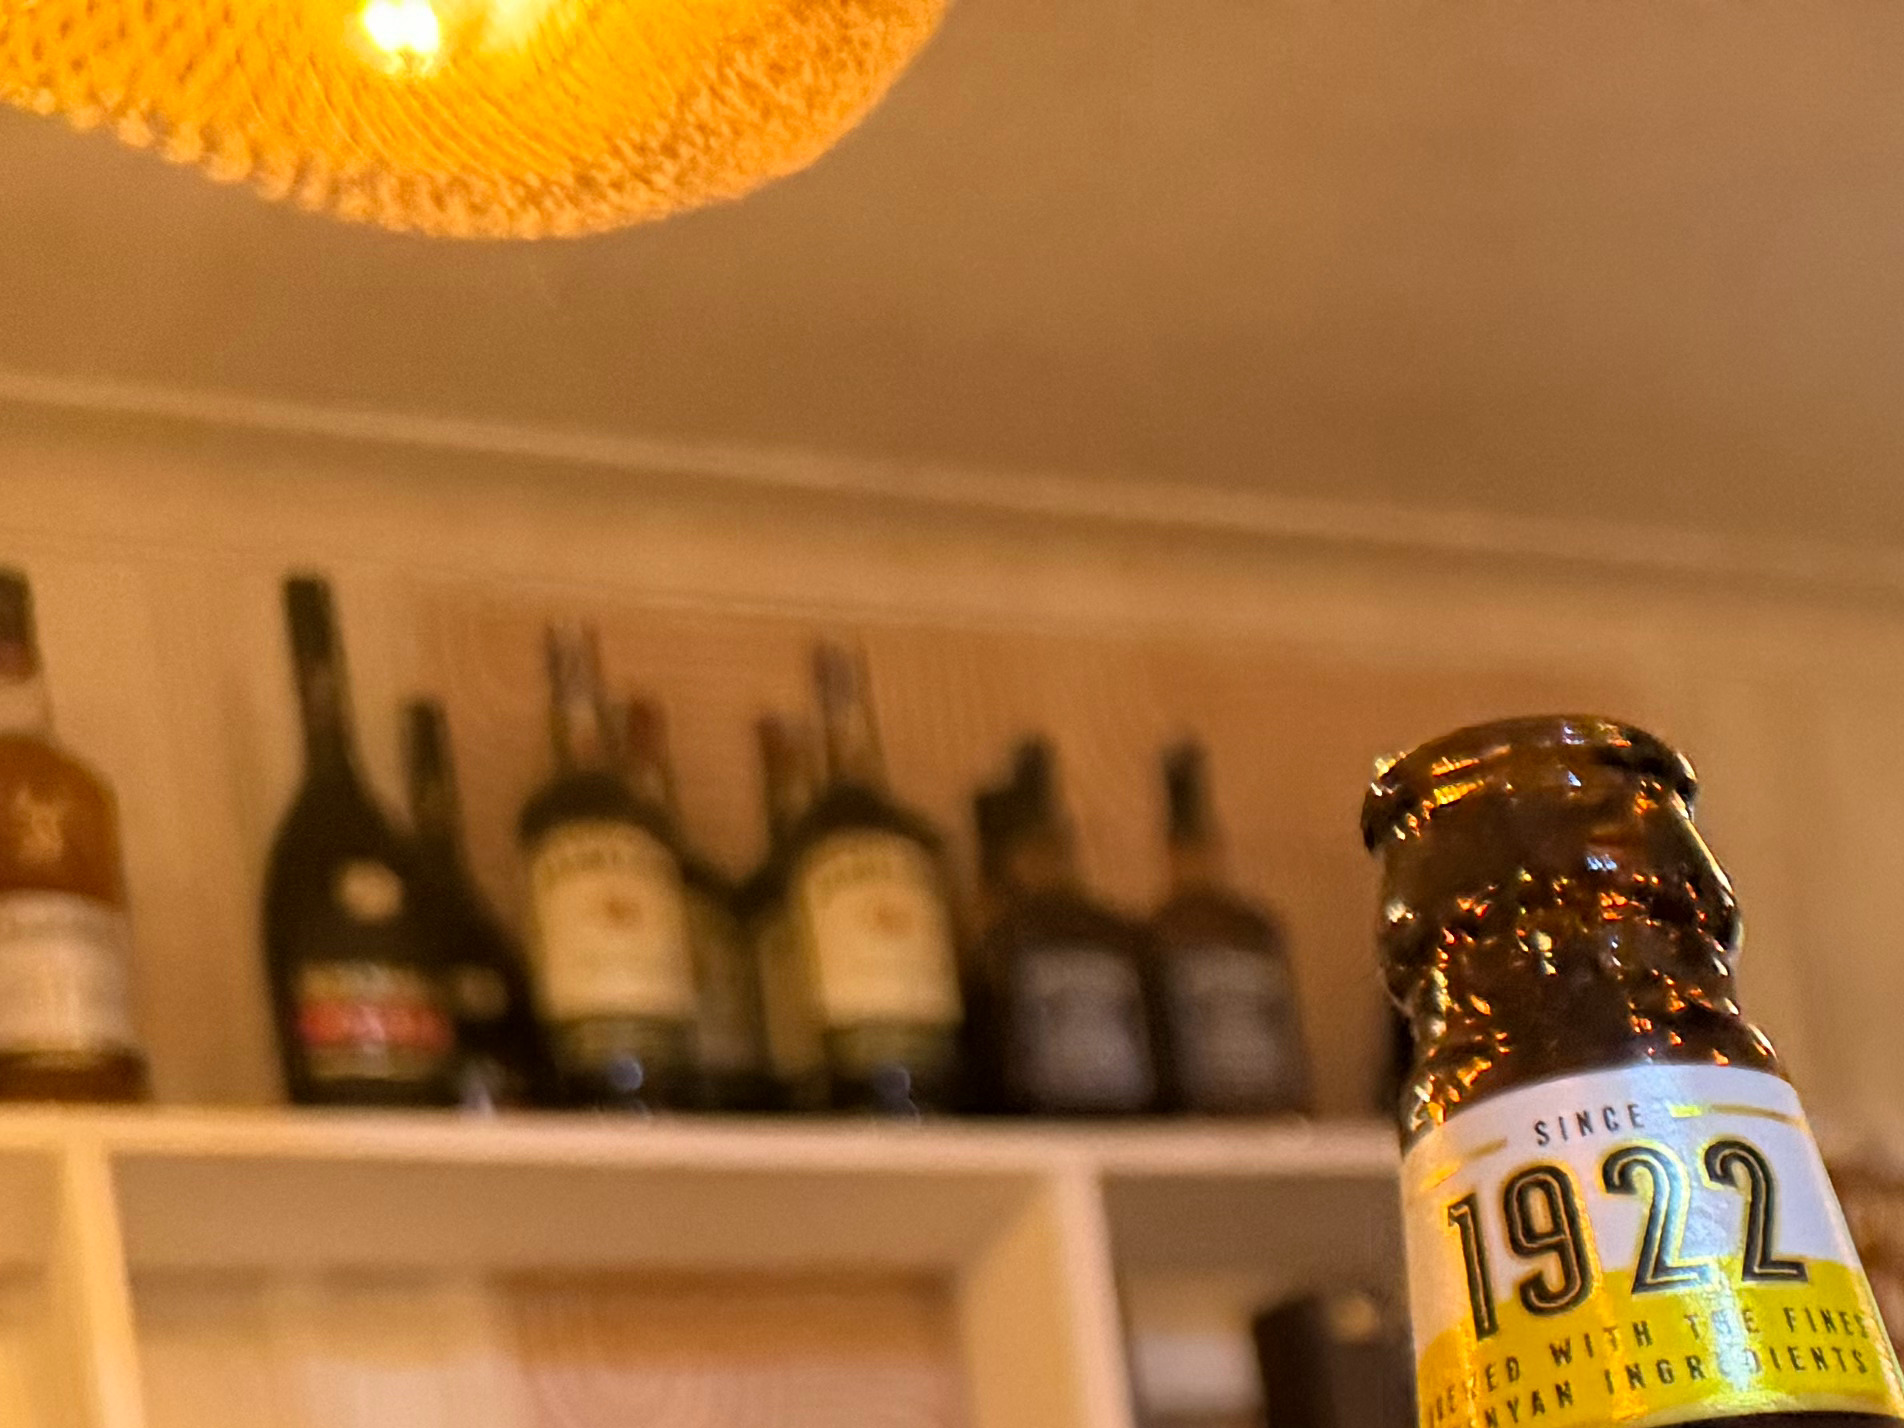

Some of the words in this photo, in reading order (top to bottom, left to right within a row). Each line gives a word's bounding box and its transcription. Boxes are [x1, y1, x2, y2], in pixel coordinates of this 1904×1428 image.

[1534, 1103, 1646, 1147] SINCE
[1446, 1138, 1810, 1341] 1922
[1549, 1319, 1654, 1368] WITH
[1683, 1307, 1761, 1341] THE
[1603, 1345, 1868, 1395] INGRDIENTS
